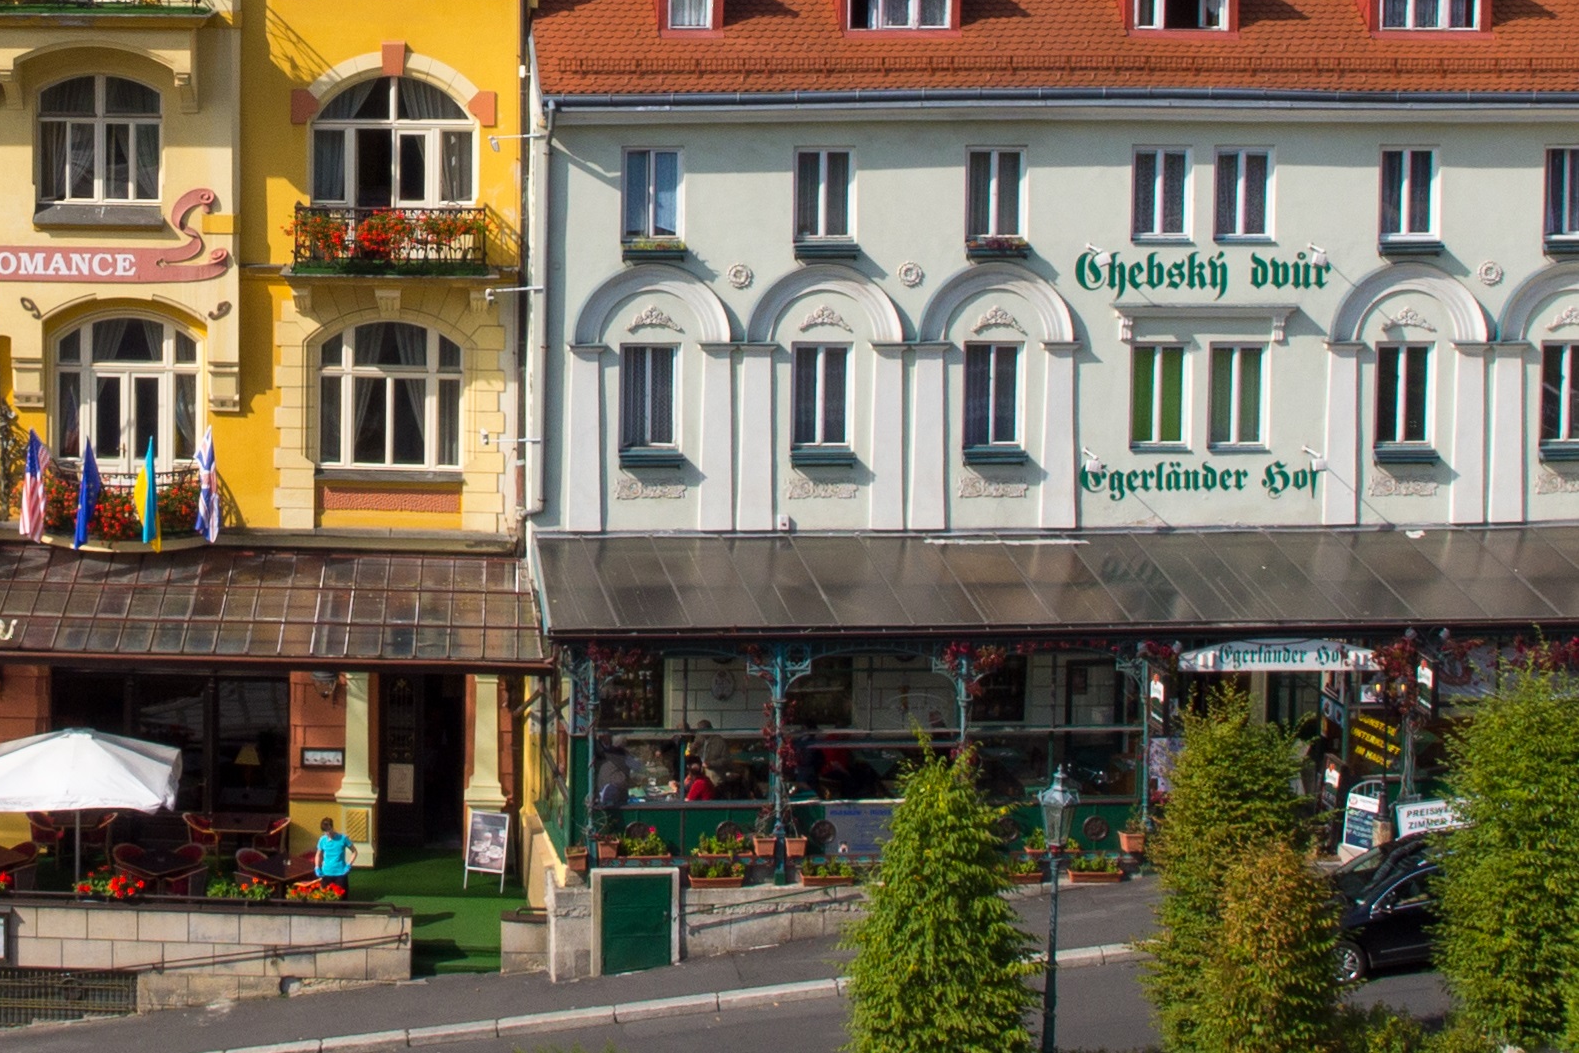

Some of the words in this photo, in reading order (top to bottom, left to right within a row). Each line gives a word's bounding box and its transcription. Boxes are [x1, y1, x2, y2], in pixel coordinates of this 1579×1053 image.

[1075, 251, 1228, 300] Chebský
[1250, 251, 1332, 290] dvůr
[1078, 460, 1250, 501] Egerländer
[1261, 460, 1322, 499] Hof
[1218, 644, 1307, 670] Egerländer
